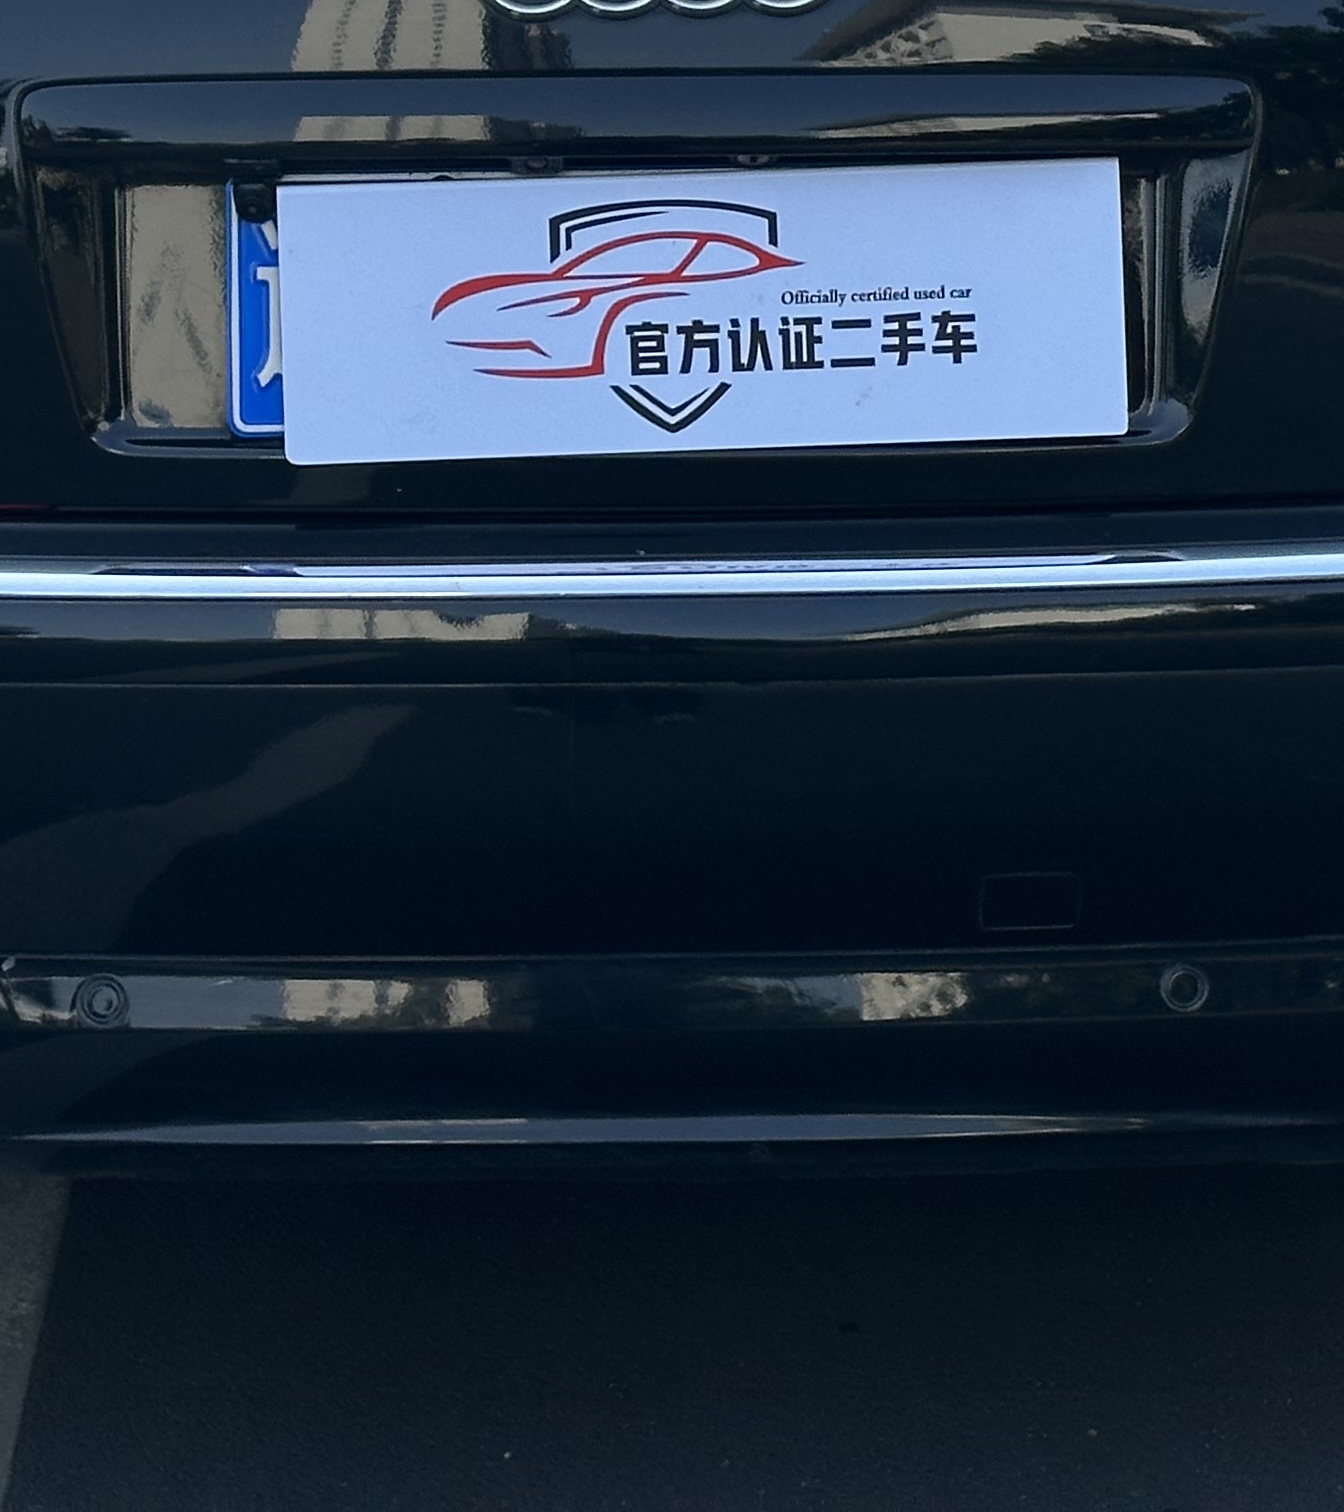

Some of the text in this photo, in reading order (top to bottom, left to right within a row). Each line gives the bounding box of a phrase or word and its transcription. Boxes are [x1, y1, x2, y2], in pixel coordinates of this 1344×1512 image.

[780, 285, 973, 308] Officially certified used car
[625, 310, 978, 377] 官方认证二手车
